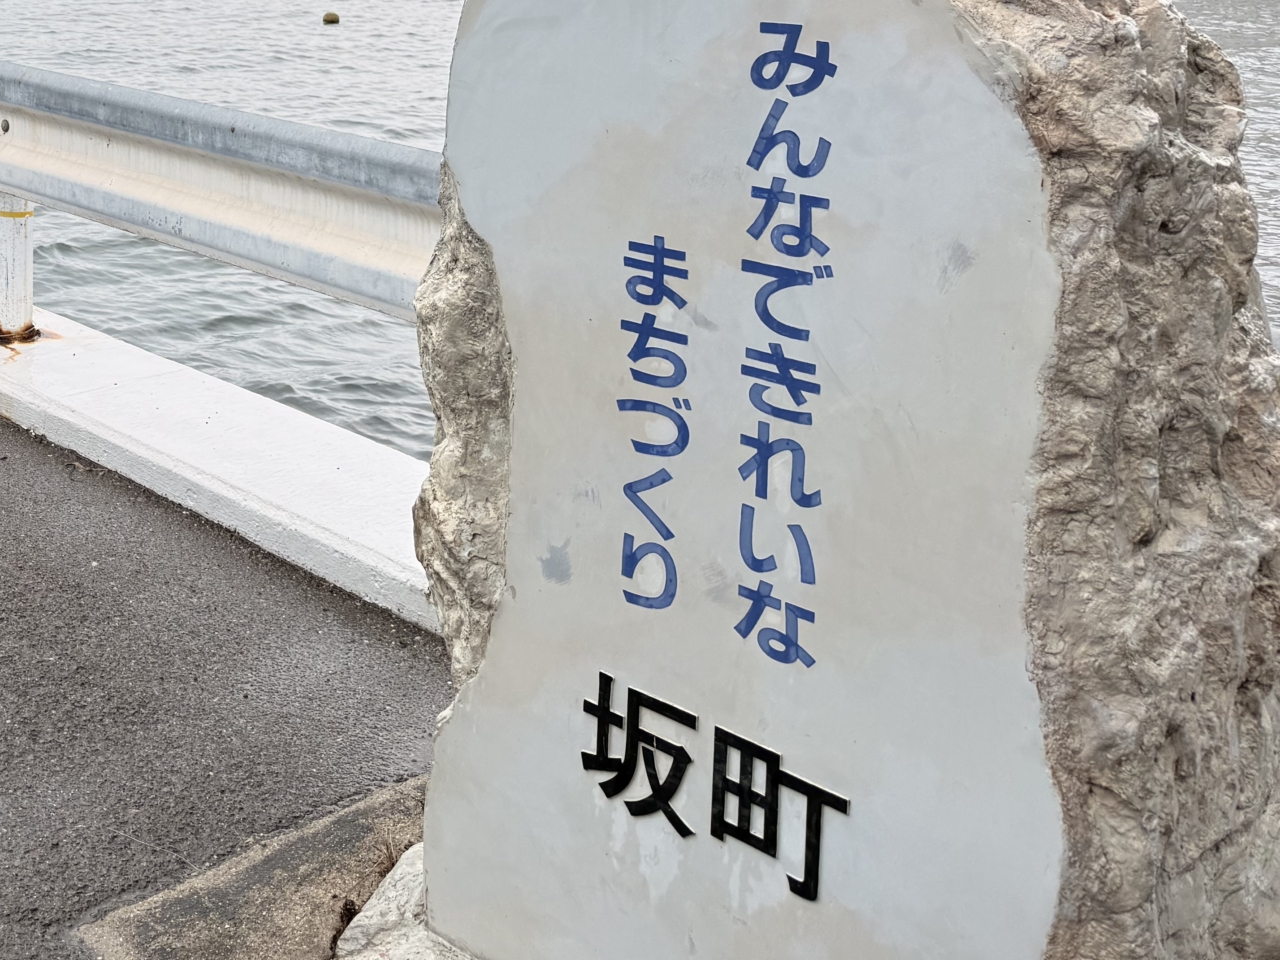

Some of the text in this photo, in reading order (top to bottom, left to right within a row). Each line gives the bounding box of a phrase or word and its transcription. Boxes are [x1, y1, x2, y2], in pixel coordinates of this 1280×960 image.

[616, 234, 692, 610] まちづくり
[732, 21, 837, 668] みんなできれいな
[580, 669, 851, 902] 坂町
